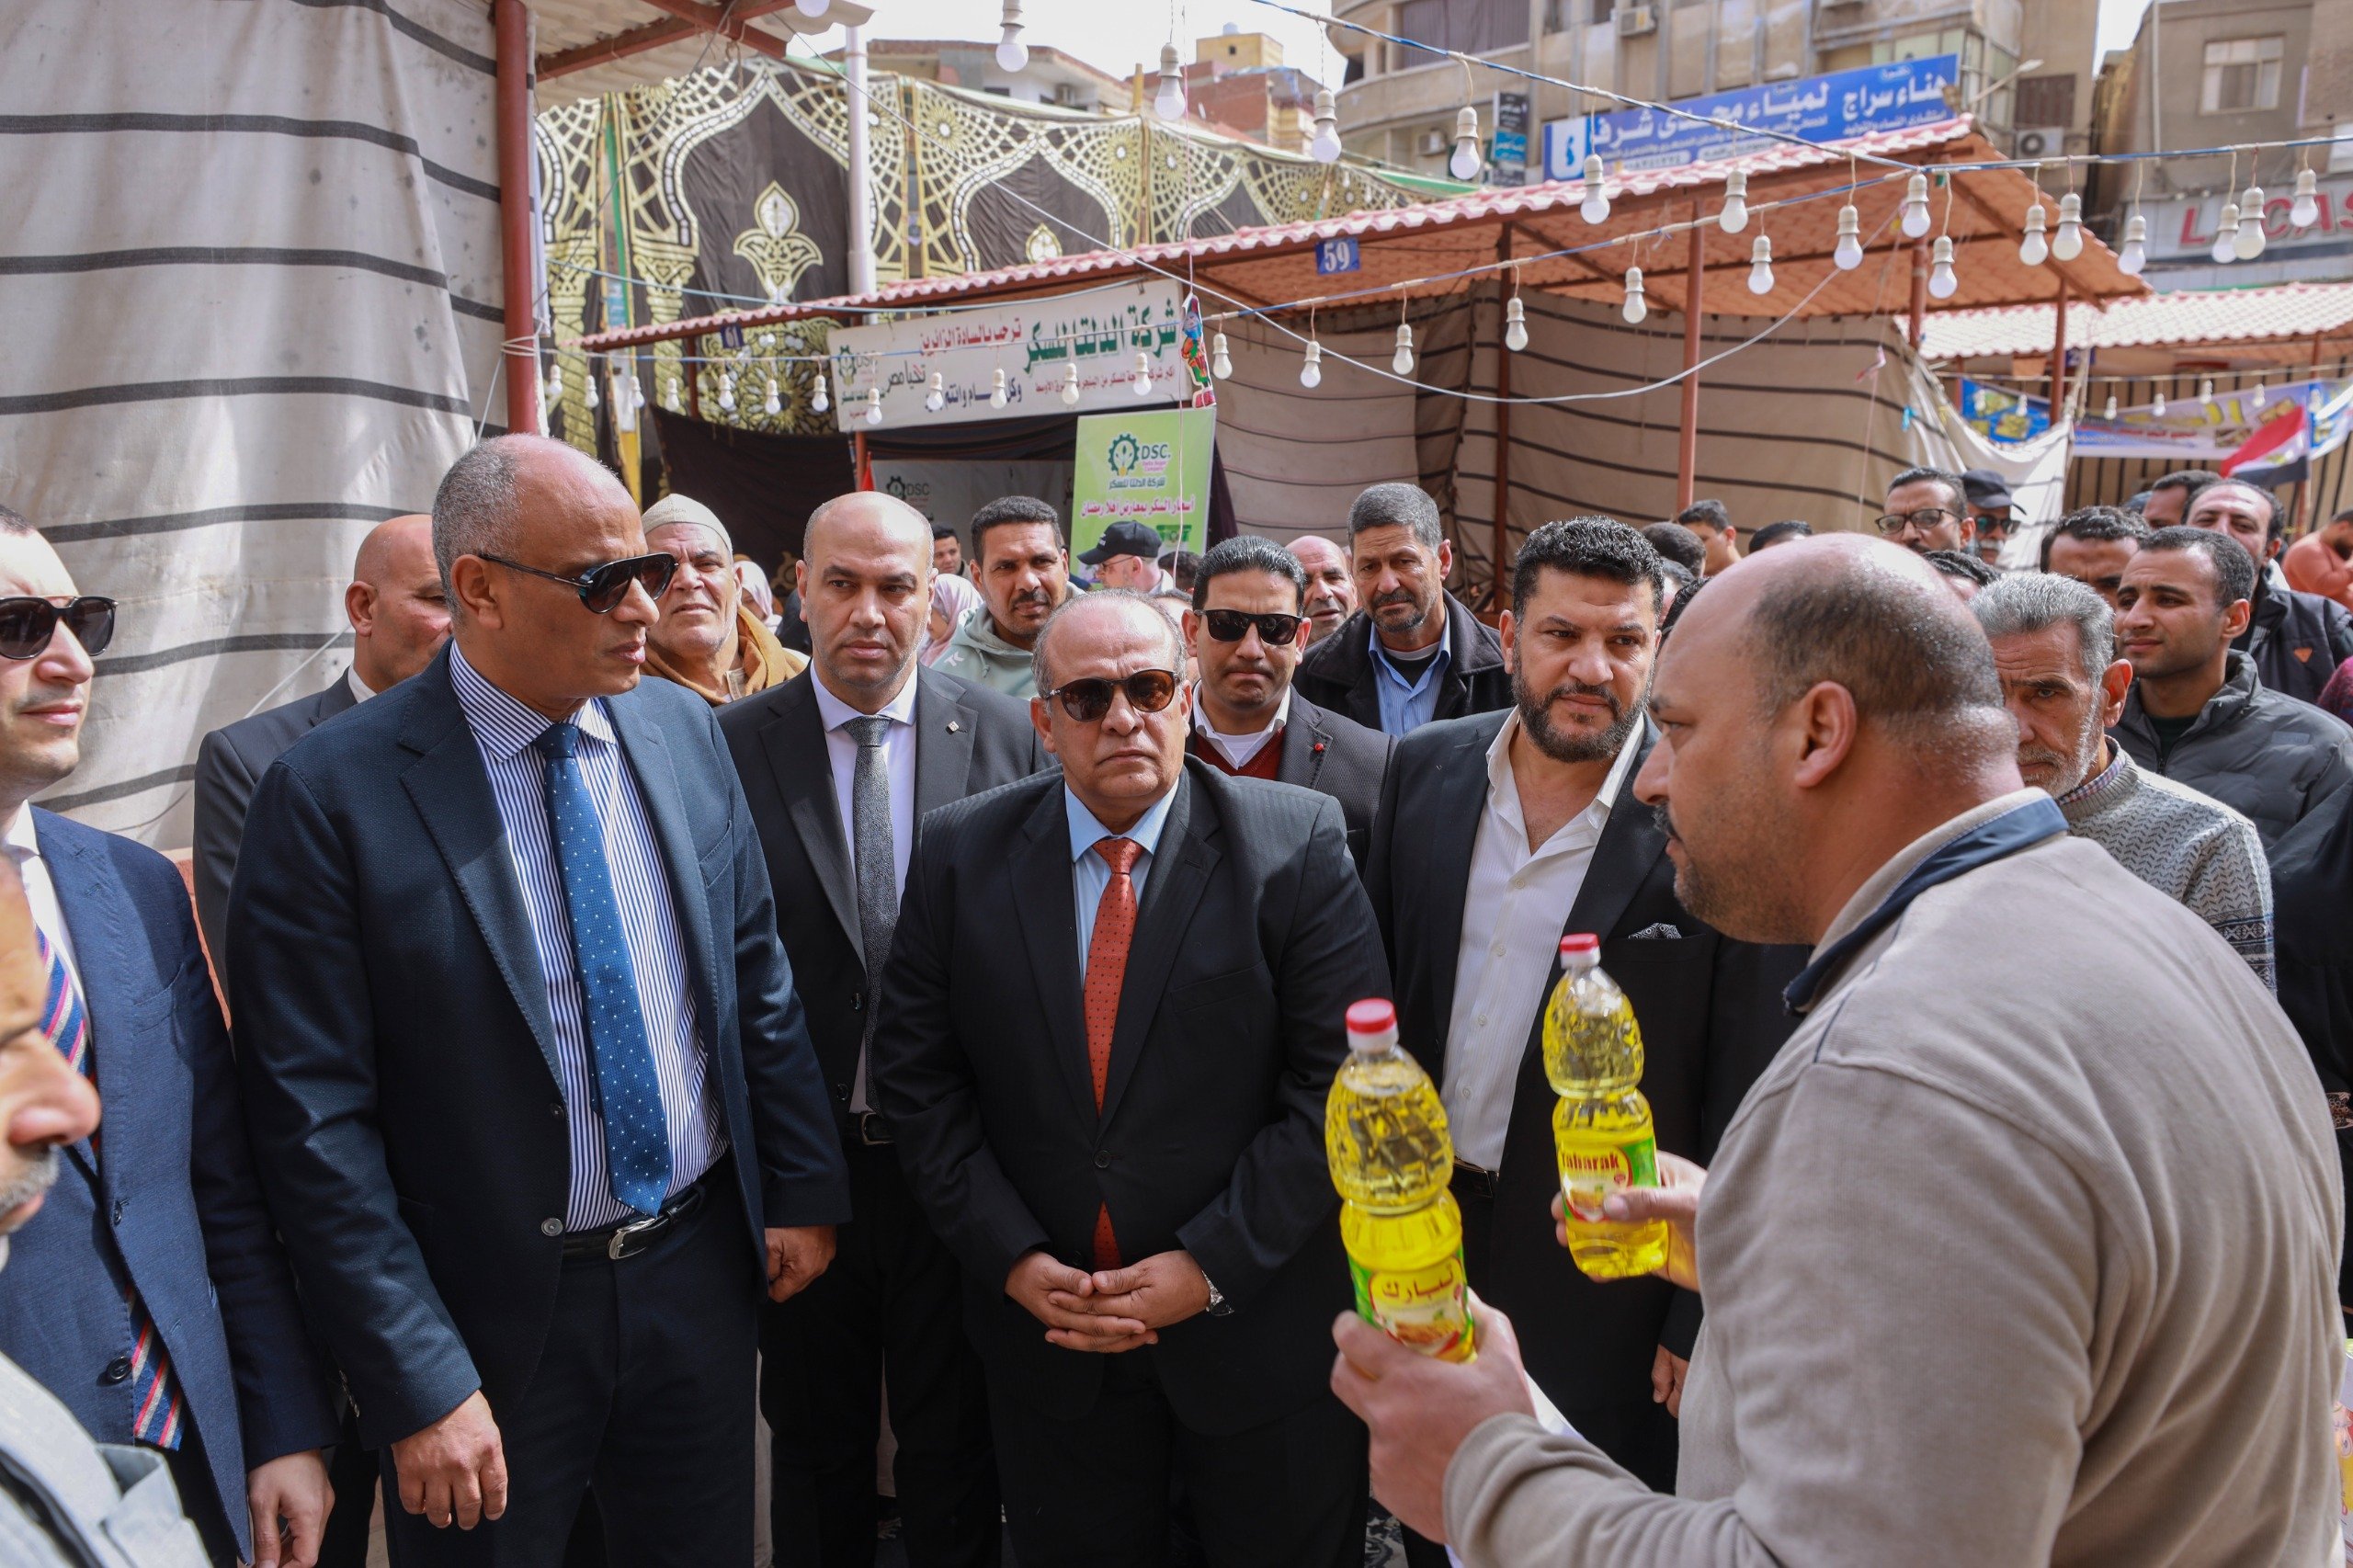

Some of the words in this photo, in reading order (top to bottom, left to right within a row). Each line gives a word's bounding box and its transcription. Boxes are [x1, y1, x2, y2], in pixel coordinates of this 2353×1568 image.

[1748, 81, 1830, 120] لمياء
[1842, 85, 1894, 121] سراج
[1897, 73, 1948, 109] هناء
[1324, 242, 1350, 271] 59
[955, 324, 992, 346] بالسادة
[994, 318, 1022, 344] ترحب
[1073, 313, 1126, 357] الدلتا
[1127, 298, 1176, 358] شركة
[919, 327, 955, 357] الزائرين
[1024, 321, 1067, 374] للسكر
[885, 372, 904, 393] مصر
[904, 360, 926, 391] تحيا
[969, 382, 992, 407] ام
[1006, 376, 1022, 403] وكل
[906, 483, 930, 496] DSC
[1109, 479, 1129, 490] للسكر
[1130, 478, 1146, 487] الدلتا
[1147, 477, 1165, 488] شركة
[1081, 502, 1104, 517] رمضان
[1120, 500, 1148, 517] بمعارض
[1149, 498, 1171, 516] السكر
[1382, 1264, 1454, 1303] تبارك
